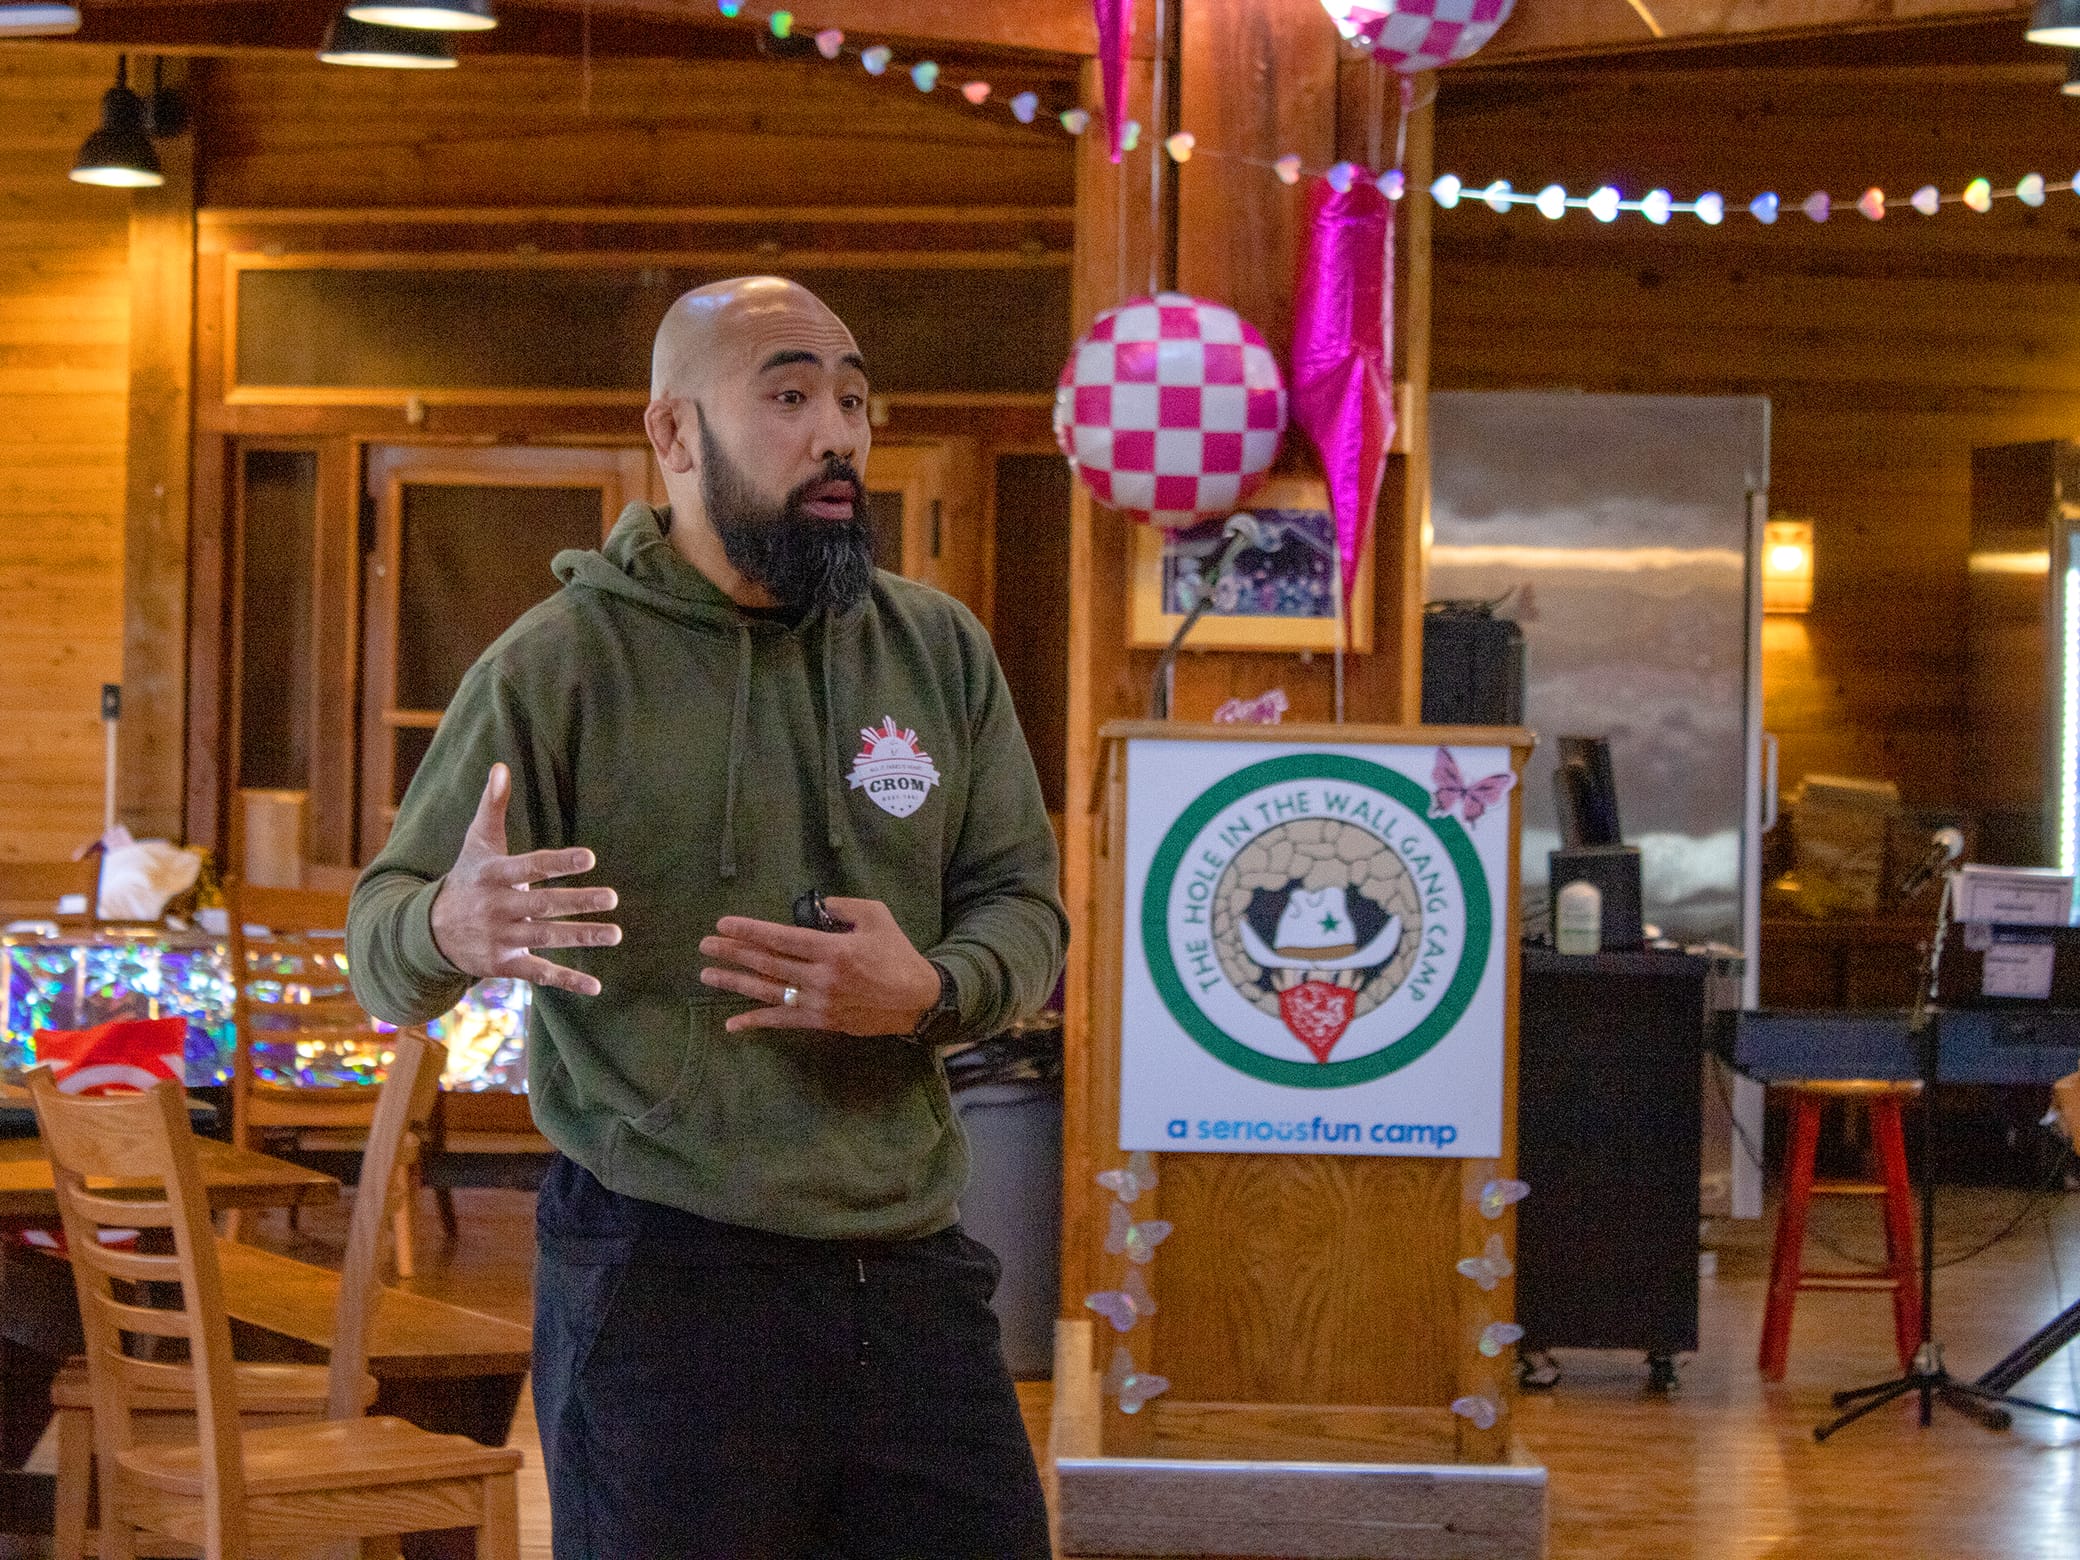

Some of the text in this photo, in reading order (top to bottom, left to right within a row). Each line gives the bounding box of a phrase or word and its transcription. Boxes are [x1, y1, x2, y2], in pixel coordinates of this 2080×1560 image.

[870, 777, 925, 793] CROM
[1184, 791, 1448, 1001] THE HOLE IN THE WALL GANG CAMP
[1166, 1118, 1189, 1140] a
[1369, 1122, 1457, 1149] camp
